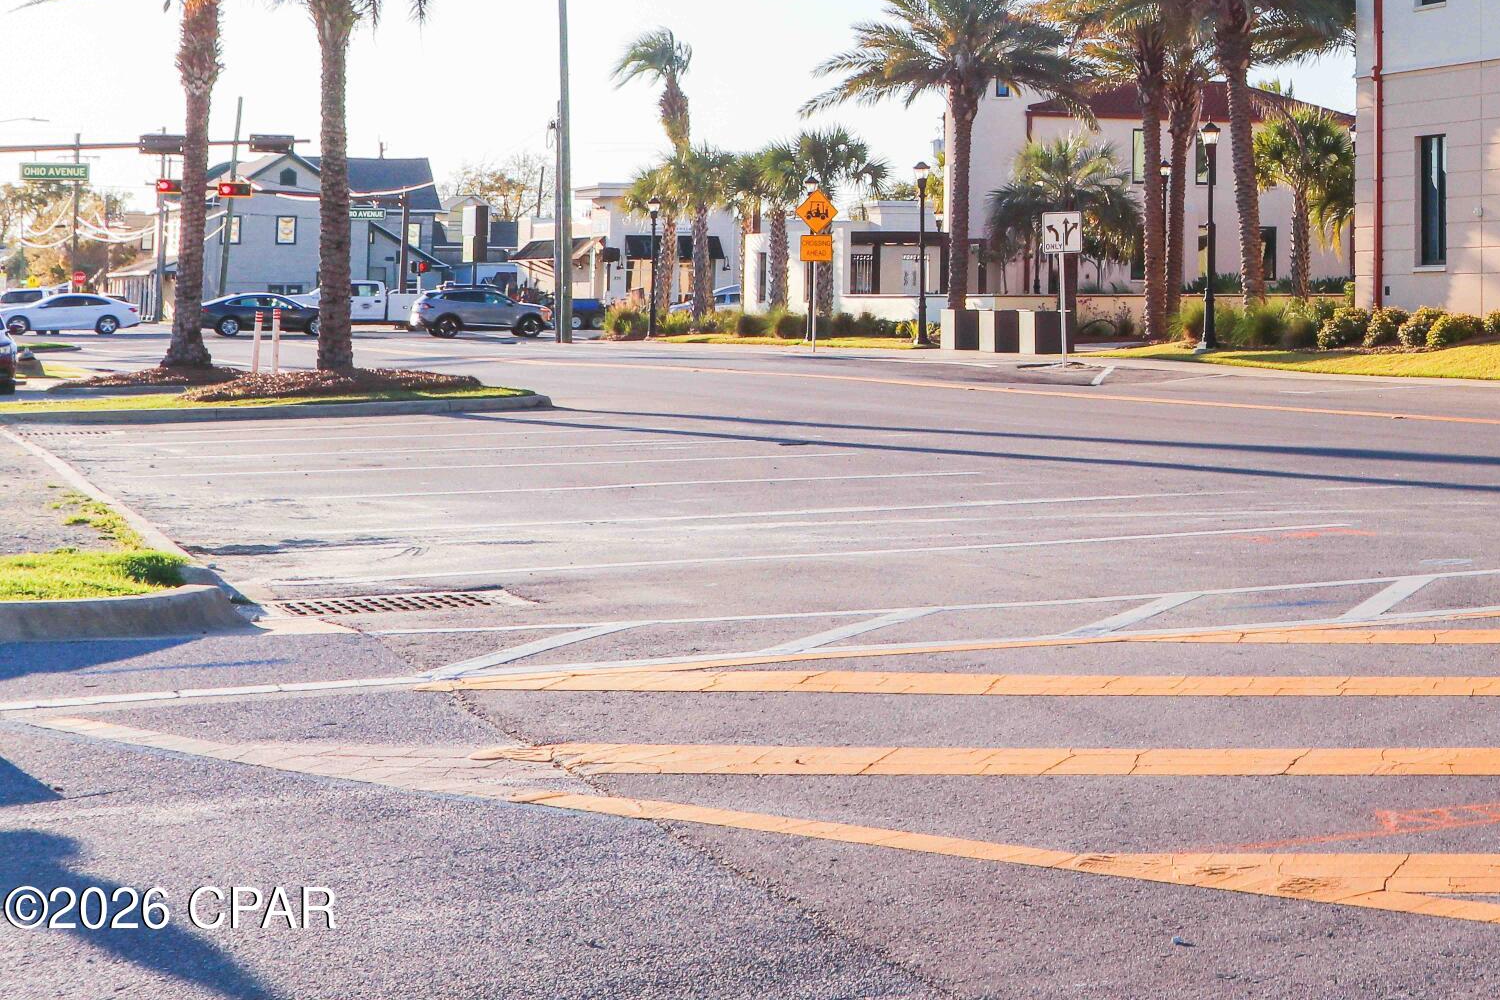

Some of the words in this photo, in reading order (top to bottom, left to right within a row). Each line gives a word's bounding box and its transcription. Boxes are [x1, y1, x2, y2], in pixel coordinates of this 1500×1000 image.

[24, 167, 46, 176] OHIO
[48, 167, 86, 176] AVENUE
[358, 210, 383, 218] AVENUE
